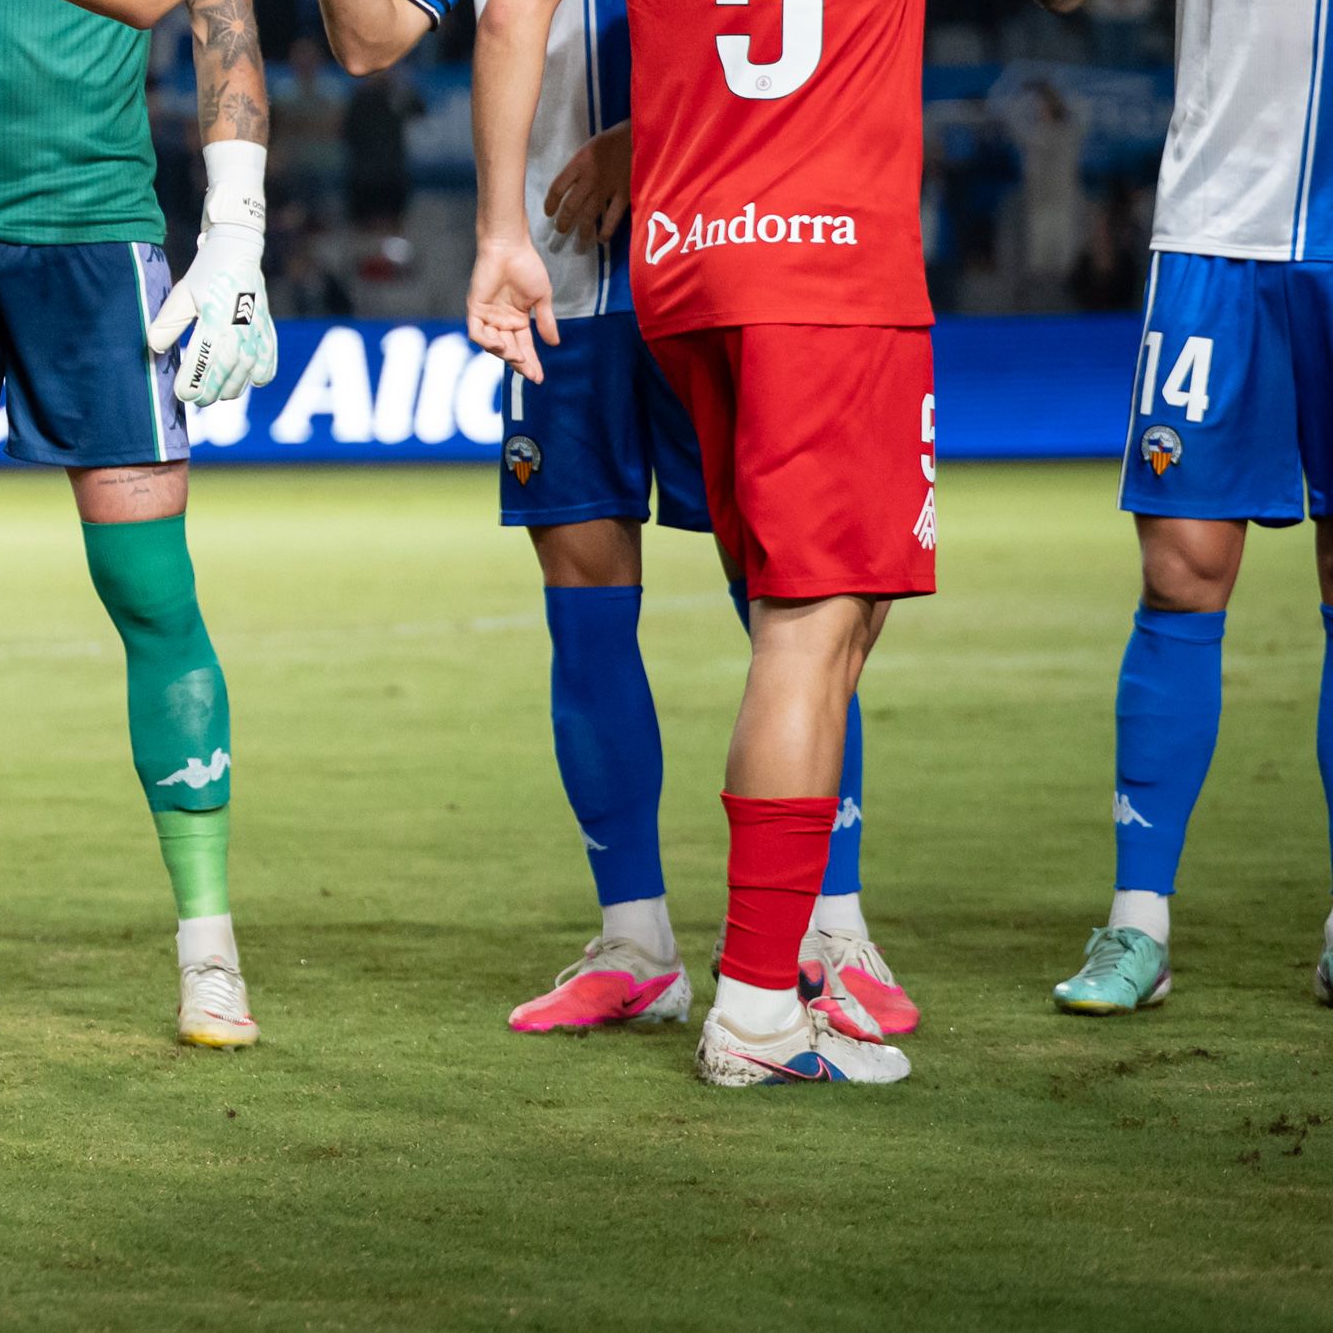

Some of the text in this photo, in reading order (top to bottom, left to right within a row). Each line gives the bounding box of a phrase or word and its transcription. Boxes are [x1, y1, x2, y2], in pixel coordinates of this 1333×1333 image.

[679, 202, 858, 254] Andorra
[189, 337, 212, 390] TWOFIVE
[1140, 331, 1213, 423] 14
